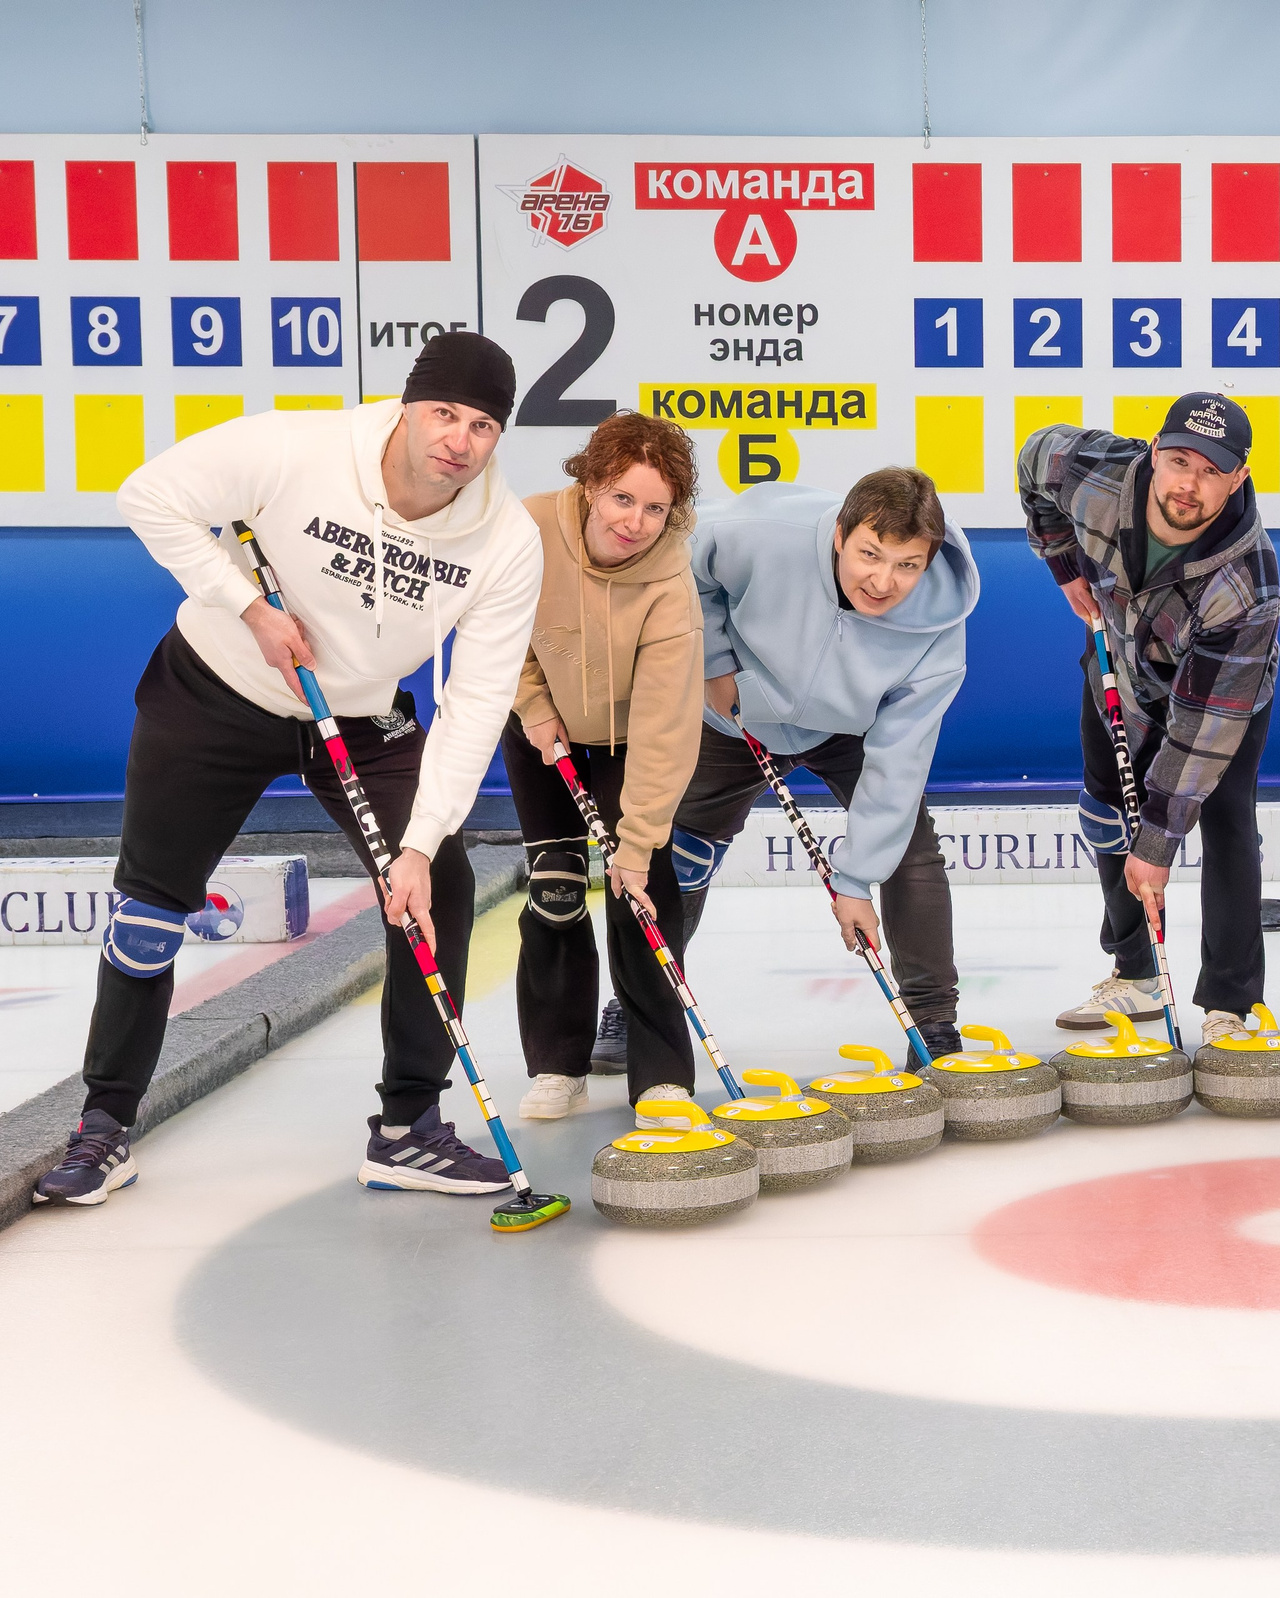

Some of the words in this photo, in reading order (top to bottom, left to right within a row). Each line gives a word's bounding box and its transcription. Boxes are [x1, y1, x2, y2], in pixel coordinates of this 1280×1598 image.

[648, 169, 864, 207] команда
[561, 213, 592, 230] 76
[88, 306, 121, 356] 8
[190, 306, 224, 356] 9
[277, 306, 340, 356] 10
[694, 303, 819, 334] номер
[935, 307, 957, 357] 1
[1028, 307, 1062, 357] 2
[1129, 307, 1162, 357] 3
[1227, 307, 1262, 357] 4
[514, 275, 618, 427] 2
[709, 338, 804, 366] энда
[651, 389, 867, 426] команда
[1189, 410, 1227, 427] NARVAL
[738, 434, 781, 484] Б
[320, 567, 363, 588] ESTABLISHED
[330, 552, 351, 574] &
[1, 891, 114, 933] CLU
